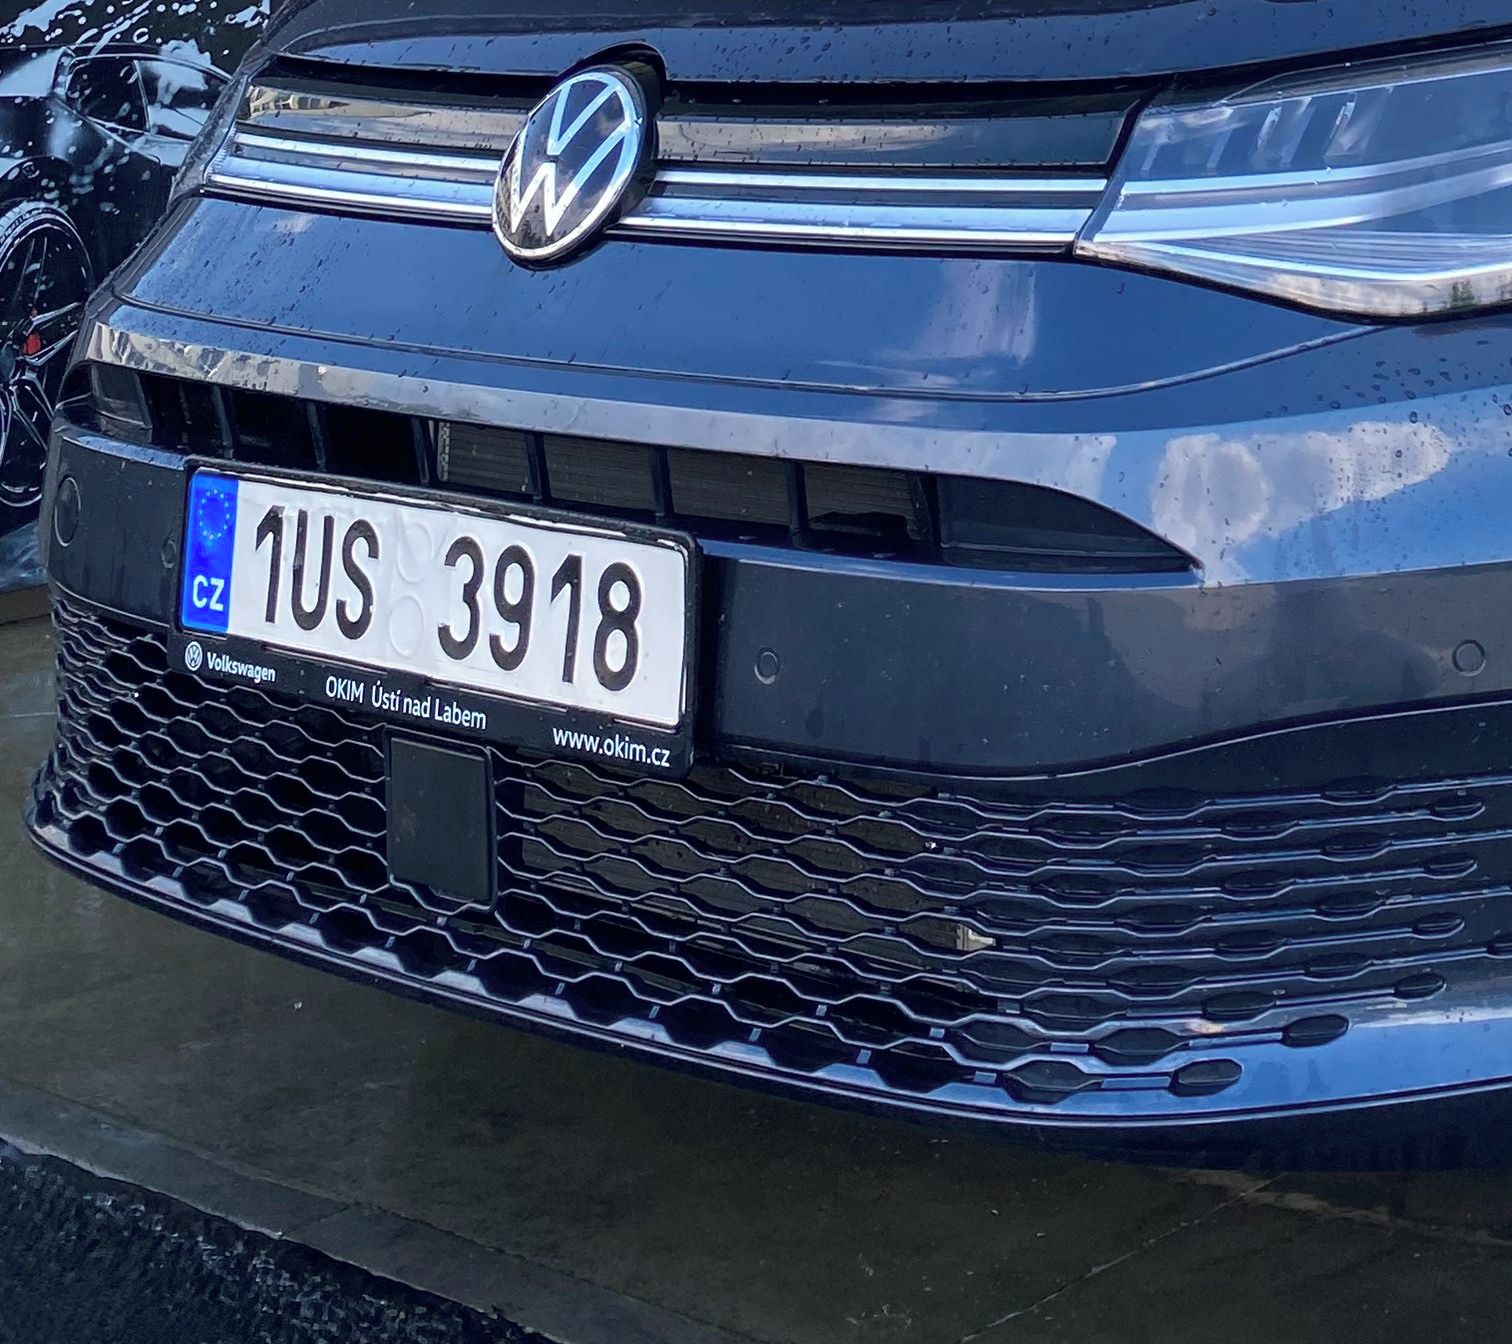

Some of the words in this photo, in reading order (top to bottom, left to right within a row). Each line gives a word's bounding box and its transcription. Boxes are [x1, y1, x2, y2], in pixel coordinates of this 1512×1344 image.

[192, 574, 225, 612] CZ
[255, 504, 380, 641] 1US
[437, 534, 642, 692] 3918
[206, 651, 277, 683] Volkswagen
[325, 675, 365, 705] OKIM
[371, 676, 402, 712] Ústí
[402, 689, 432, 719] nad
[434, 696, 487, 730] Labem
[552, 727, 671, 768] www.okim.cz
